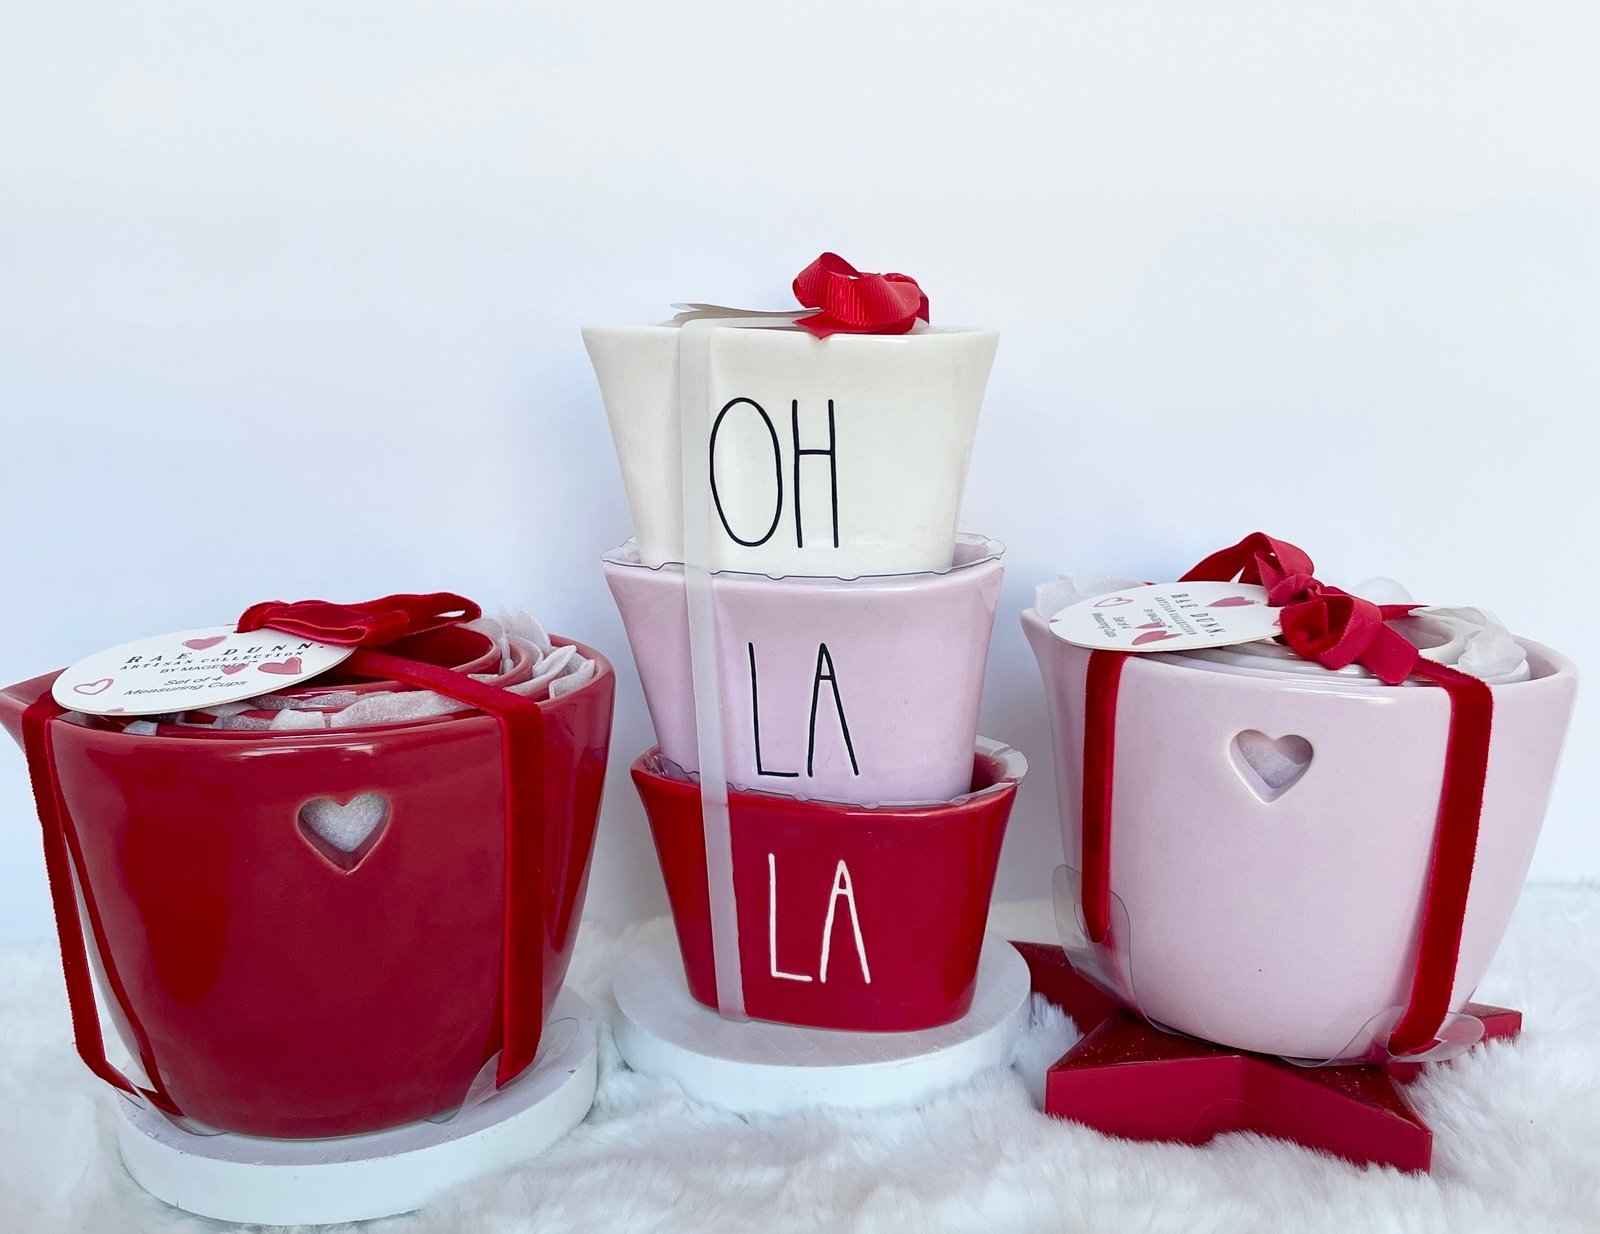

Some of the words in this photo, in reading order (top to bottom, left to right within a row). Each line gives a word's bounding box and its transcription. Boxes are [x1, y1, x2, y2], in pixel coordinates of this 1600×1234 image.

[709, 397, 838, 548] OH
[120, 660, 193, 670] ARTISAN
[201, 651, 303, 663] COLLECTION
[123, 685, 204, 695] Measuring
[126, 653, 192, 664] RAE
[221, 642, 324, 655] DUNN.
[750, 642, 859, 777] LA
[768, 853, 870, 984] LA
